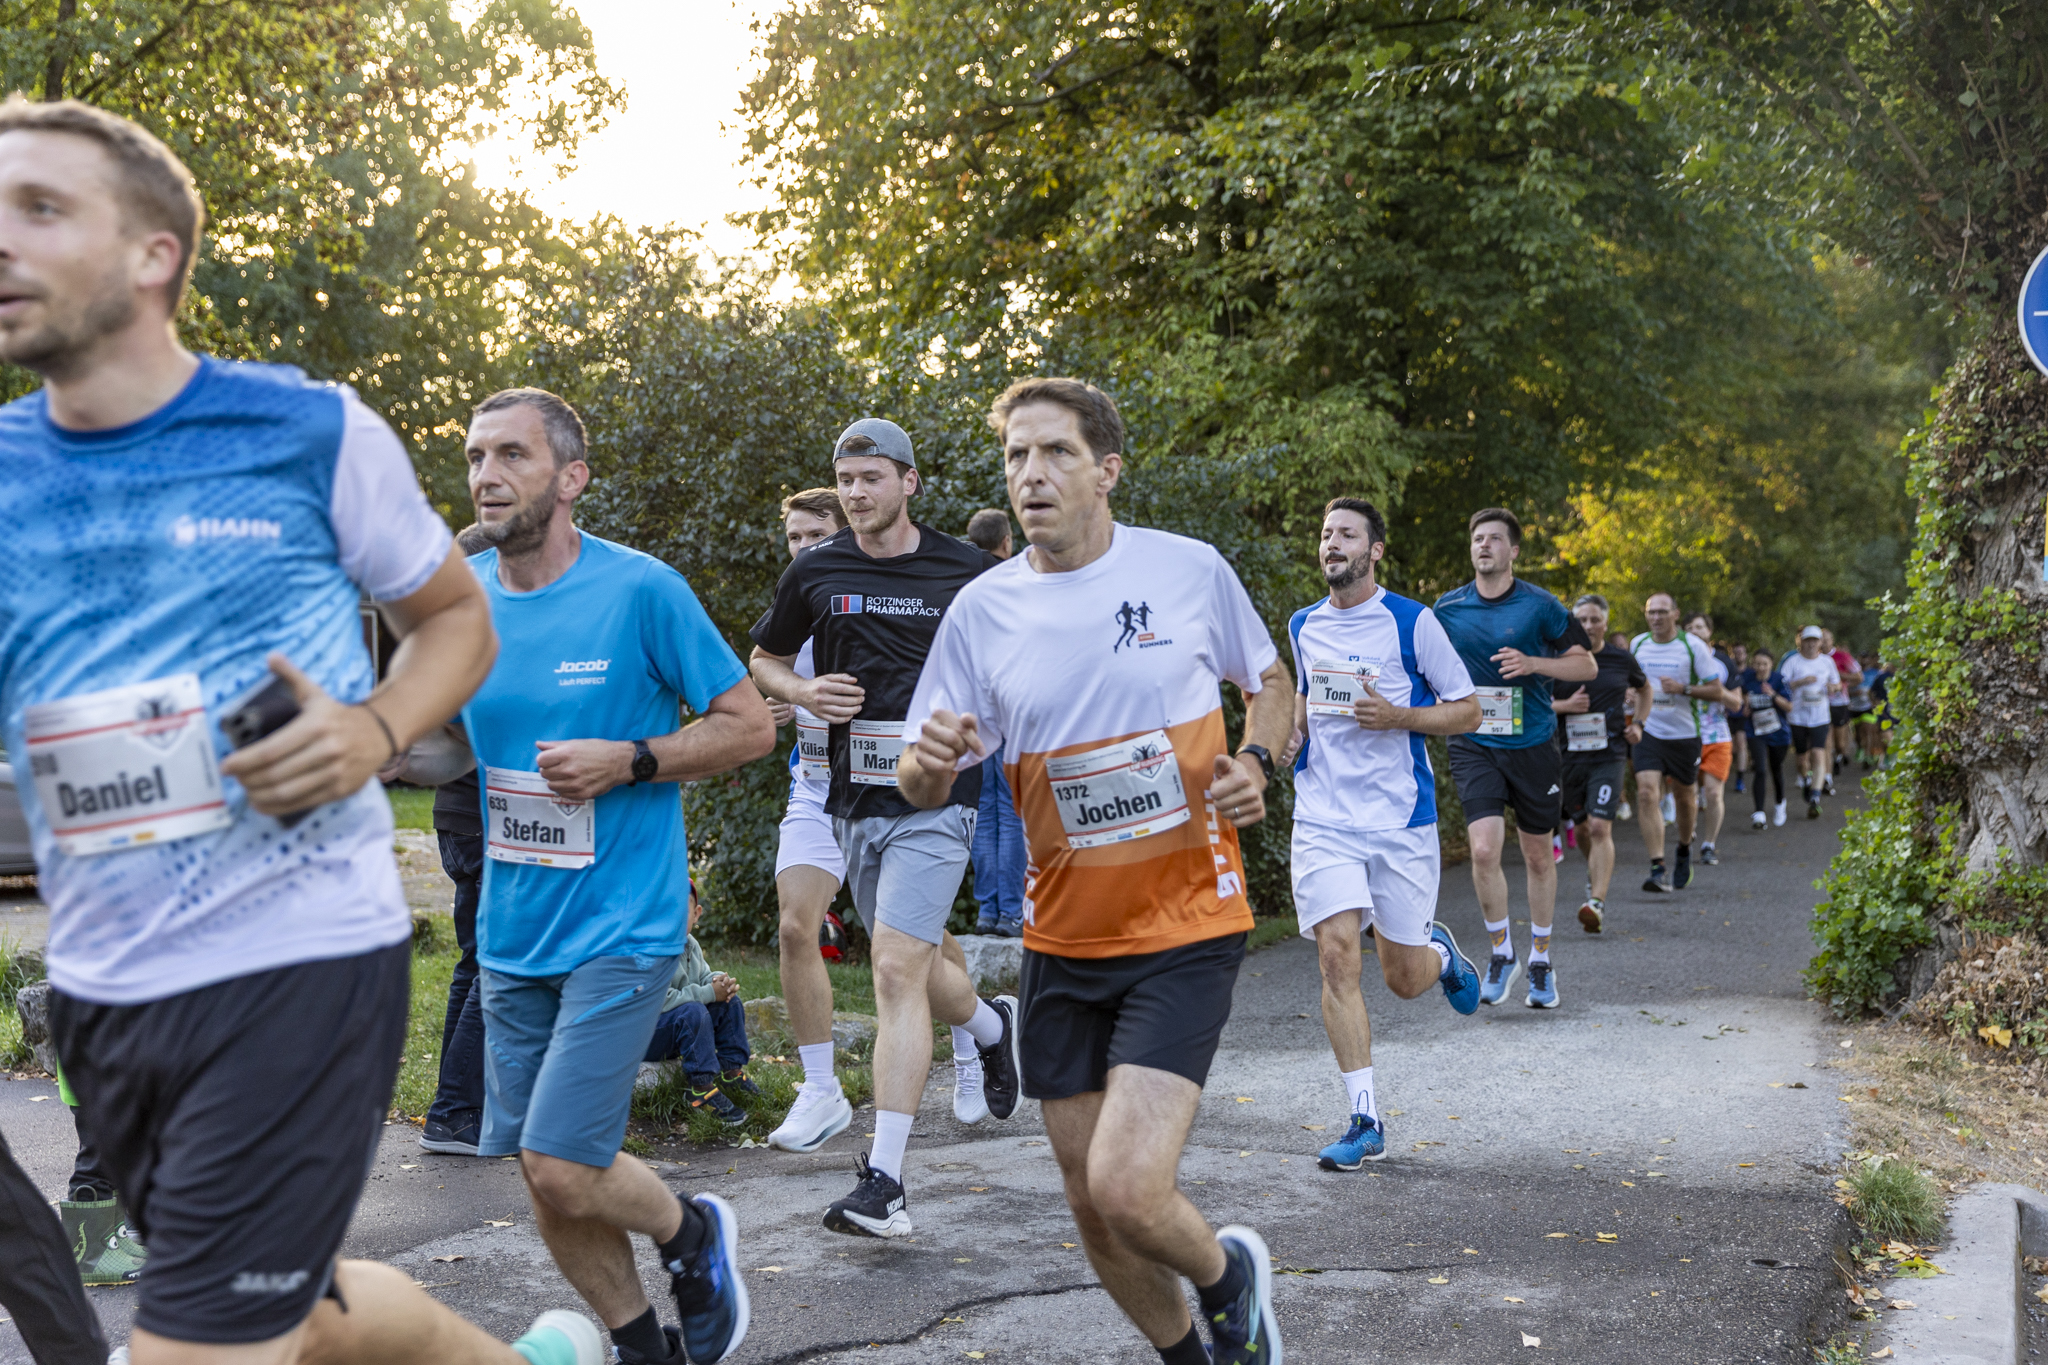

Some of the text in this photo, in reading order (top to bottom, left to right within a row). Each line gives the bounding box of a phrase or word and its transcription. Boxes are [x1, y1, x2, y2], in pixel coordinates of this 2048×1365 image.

[866, 597, 923, 607] ROTZINGER
[866, 605, 940, 616] PHARMAPACK
[1139, 639, 1173, 648] RUNNERS
[554, 660, 608, 673] Jacob
[576, 677, 606, 685] PERFECT
[1312, 675, 1329, 684] 1700
[1325, 687, 1351, 702] Tom
[852, 740, 877, 750] 1138
[57, 765, 168, 818] Daniel
[1055, 784, 1090, 801] 1372
[1597, 784, 1612, 805] 9
[489, 796, 508, 811] 633
[1076, 790, 1162, 826] Jochen
[503, 816, 565, 844] Stefan
